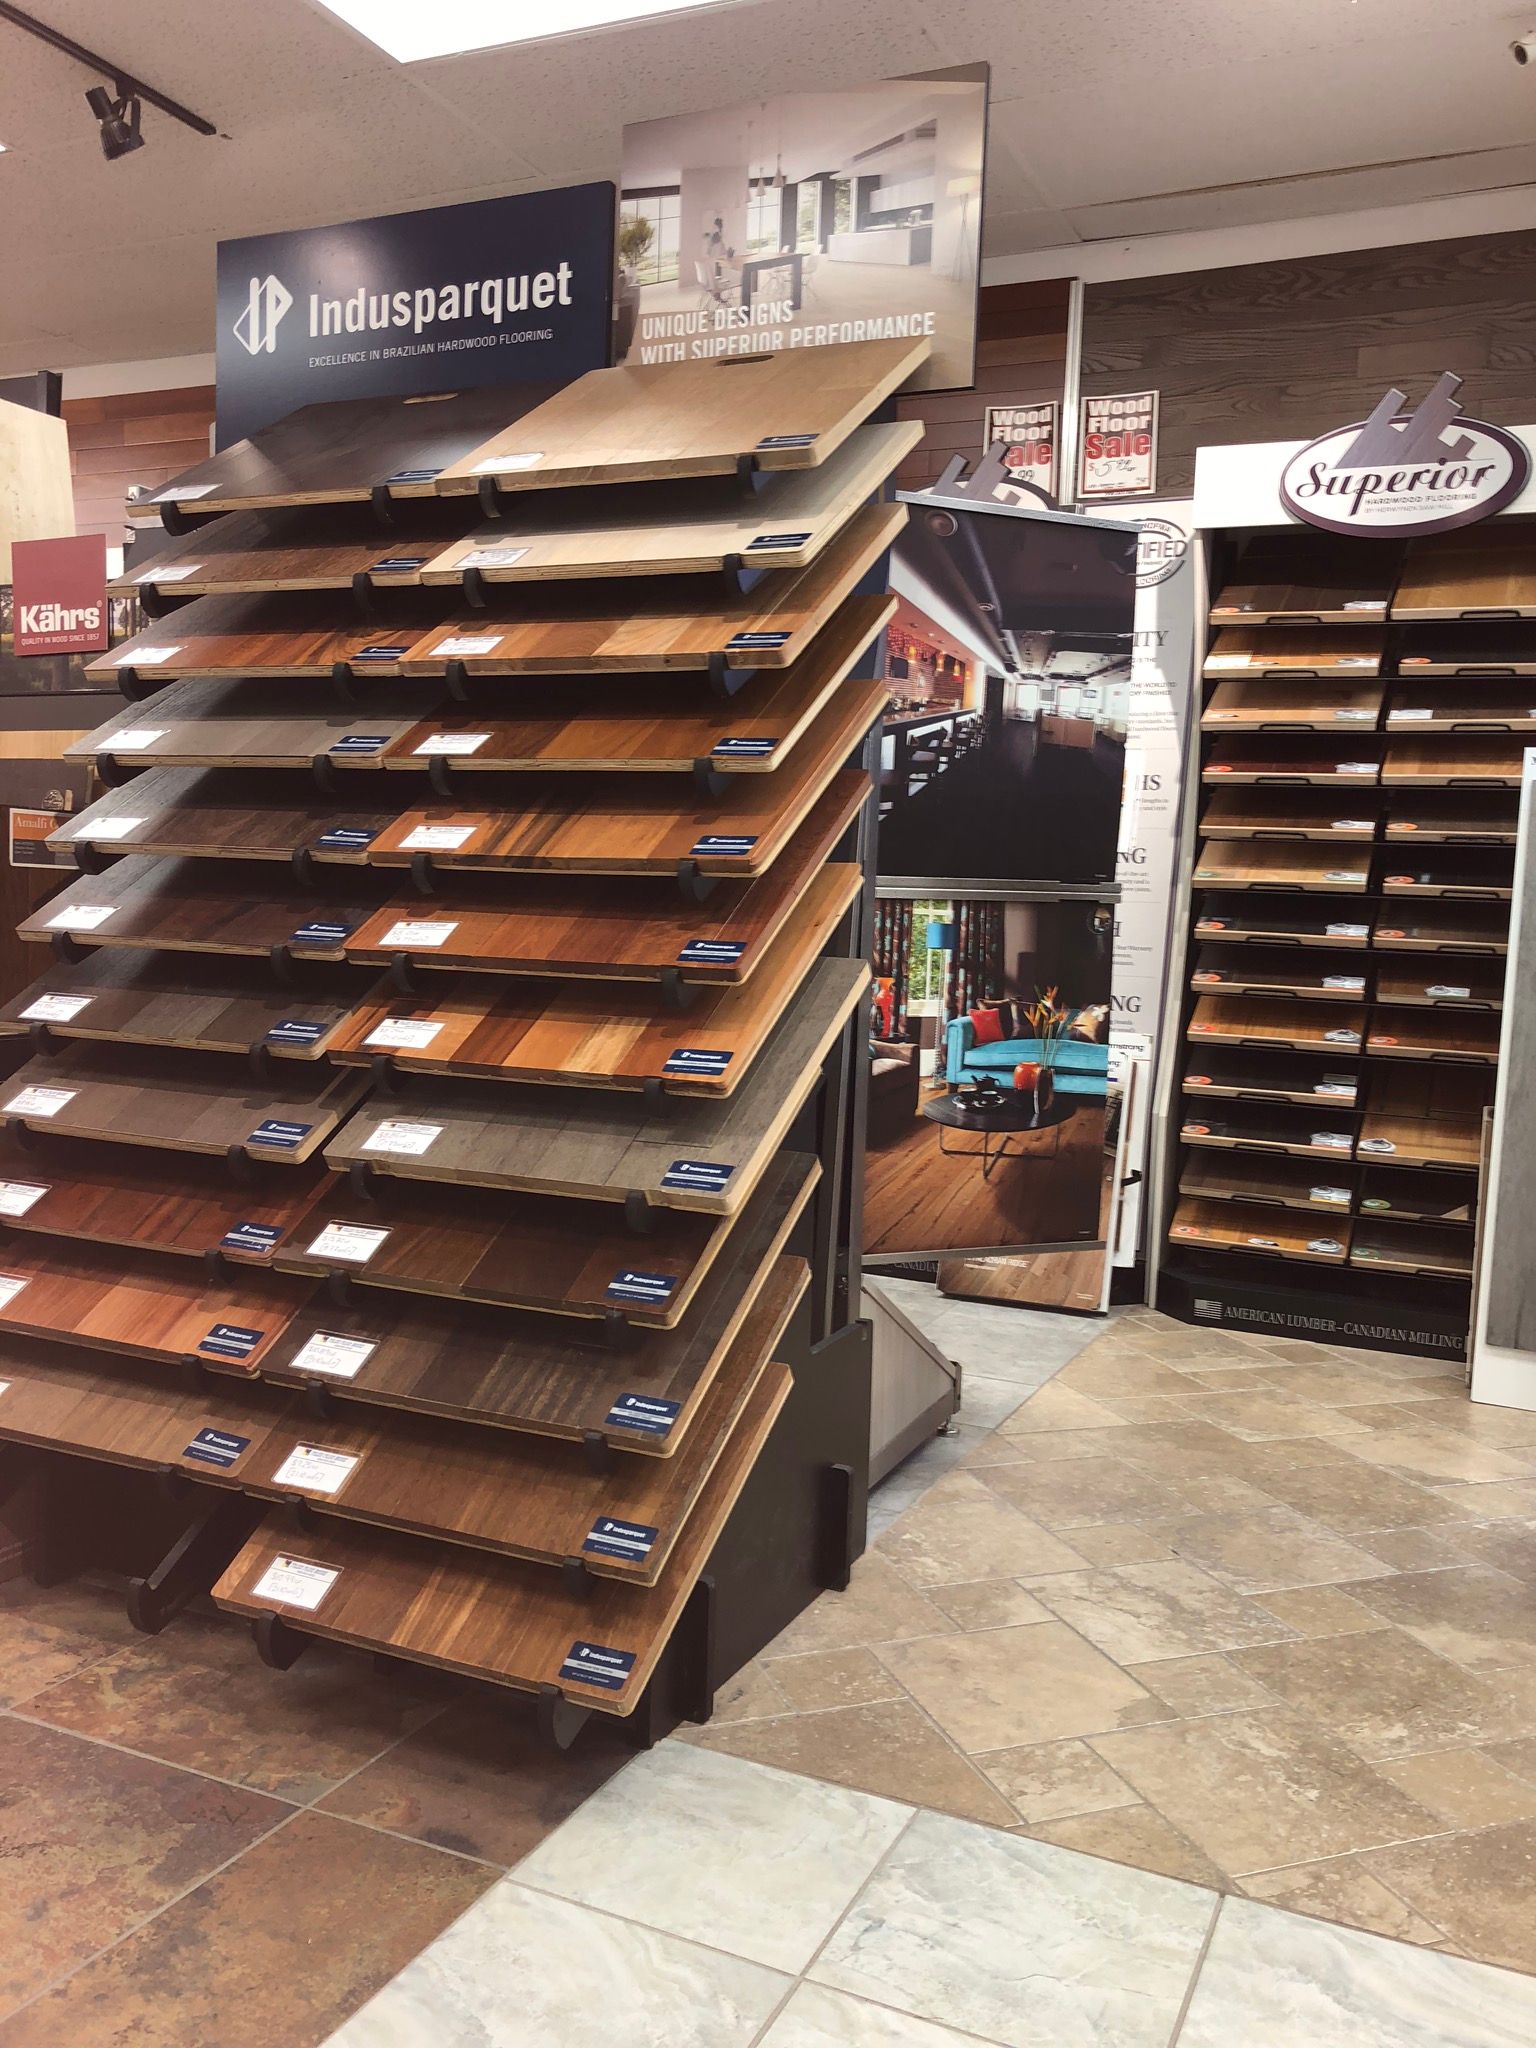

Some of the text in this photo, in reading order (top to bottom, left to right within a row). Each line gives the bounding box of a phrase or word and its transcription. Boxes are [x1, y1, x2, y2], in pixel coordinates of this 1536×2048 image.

[309, 261, 573, 338] Indusparquet
[642, 300, 794, 340] UNIQUE DESIGNS
[308, 328, 553, 368] EXCELLENCE IN BRAZILIAN HARDWOOD FLOORING
[640, 312, 936, 365] WITH SUPERIOR PERFORMANCE
[992, 407, 1052, 426] Wood
[1088, 396, 1152, 416] Wood
[991, 425, 1052, 442] Floor
[1088, 415, 1151, 433] Floor
[1004, 441, 1052, 468] ale
[1085, 431, 1152, 460] Sale
[1297, 457, 1496, 516] Superior
[20, 603, 100, 633] Kährs
[1224, 1306, 1285, 1325] AMERICAN
[1409, 1331, 1464, 1350] MILLING
